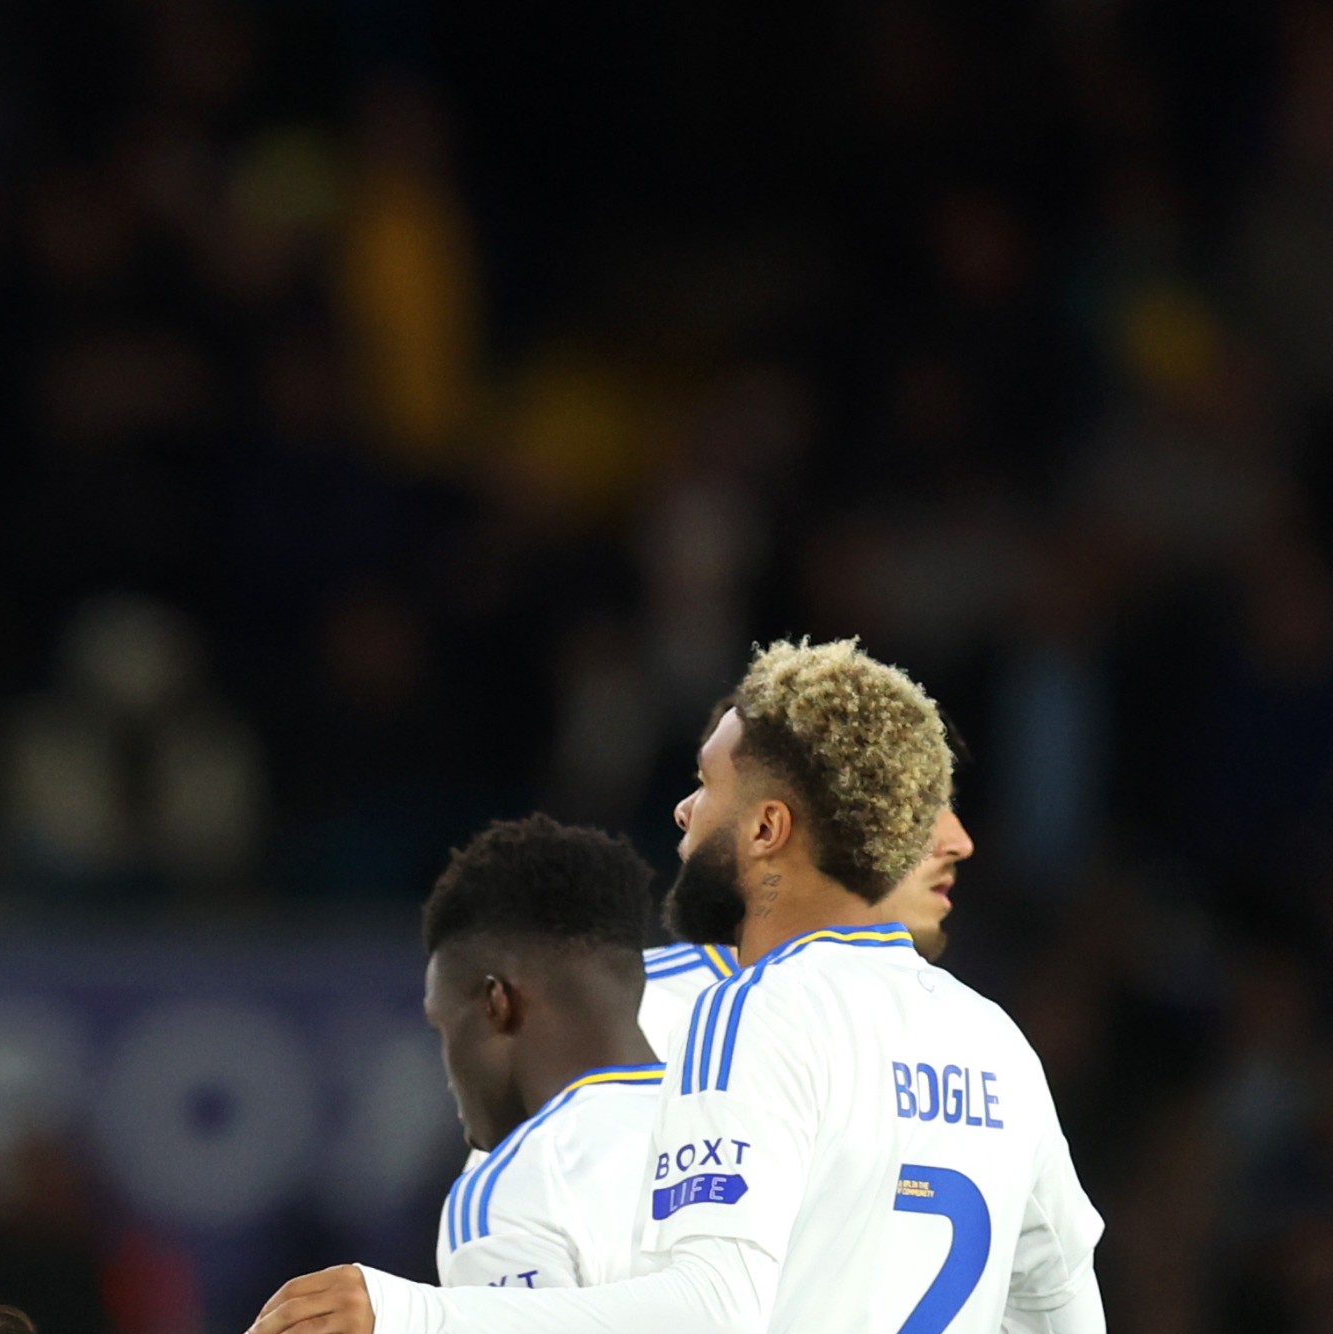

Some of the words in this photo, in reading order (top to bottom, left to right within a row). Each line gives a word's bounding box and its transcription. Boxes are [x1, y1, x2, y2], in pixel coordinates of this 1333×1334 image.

[892, 1061, 1004, 1129] BOGLE
[655, 1137, 751, 1180] BOXT
[669, 1176, 727, 1212] LIFE
